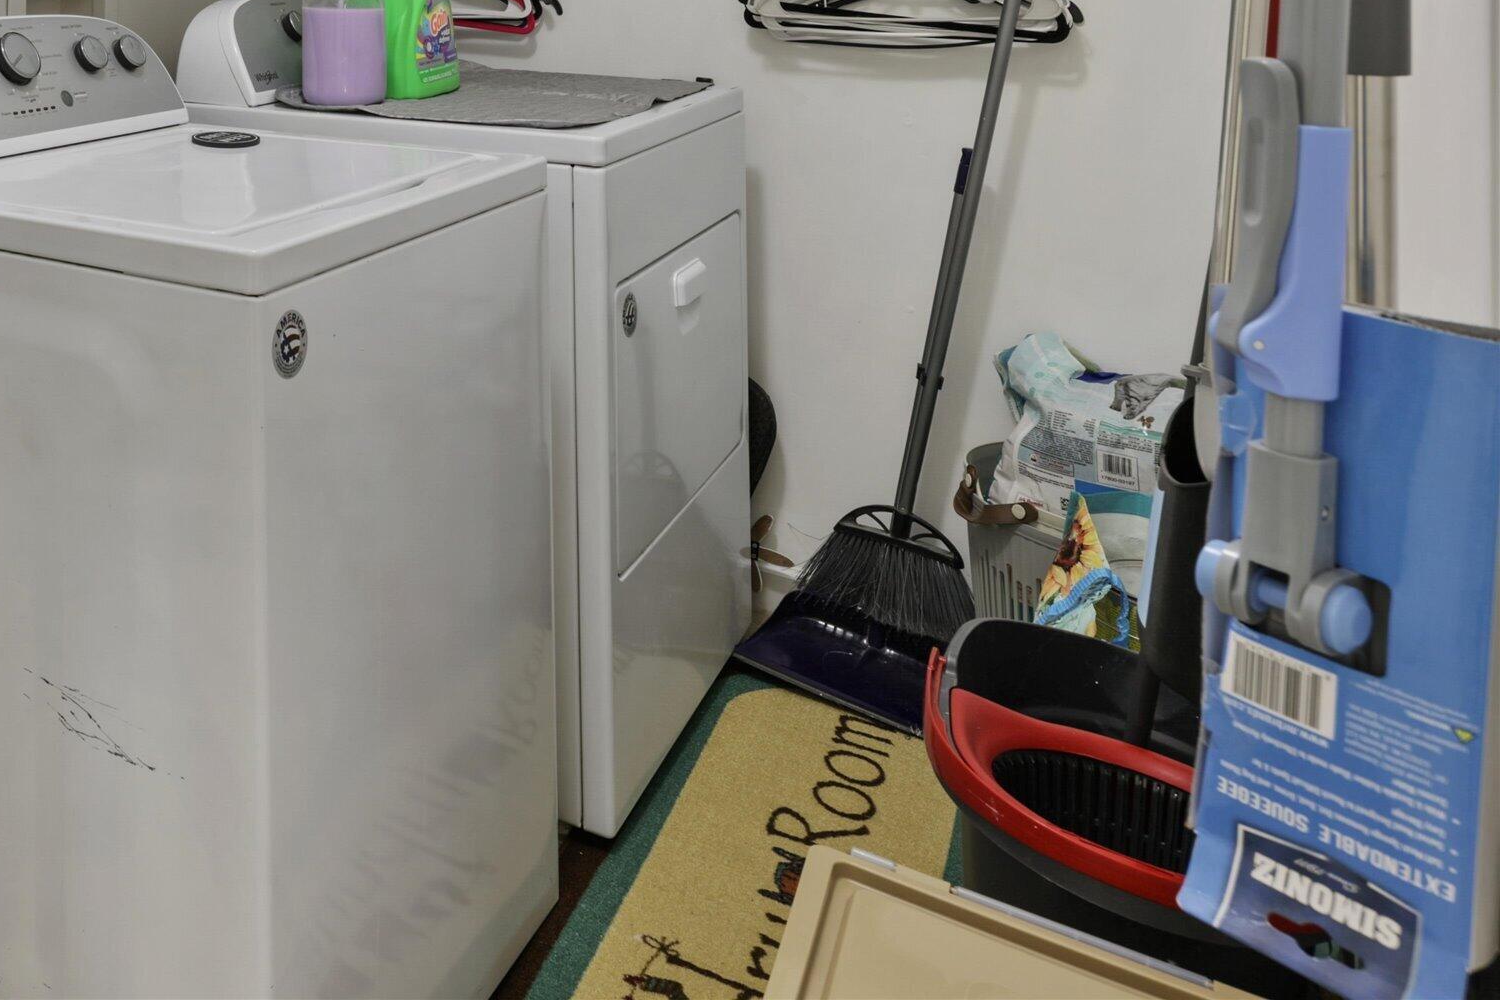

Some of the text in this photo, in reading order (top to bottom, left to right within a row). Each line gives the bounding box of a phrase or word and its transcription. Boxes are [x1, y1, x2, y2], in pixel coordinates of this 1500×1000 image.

[276, 312, 306, 338] AMERICA
[766, 713, 902, 846] Room
[1216, 774, 1310, 834] SQUEEGEE
[1250, 850, 1403, 951] SIMONIZ
[1318, 823, 1457, 903] EXTENDABLE
